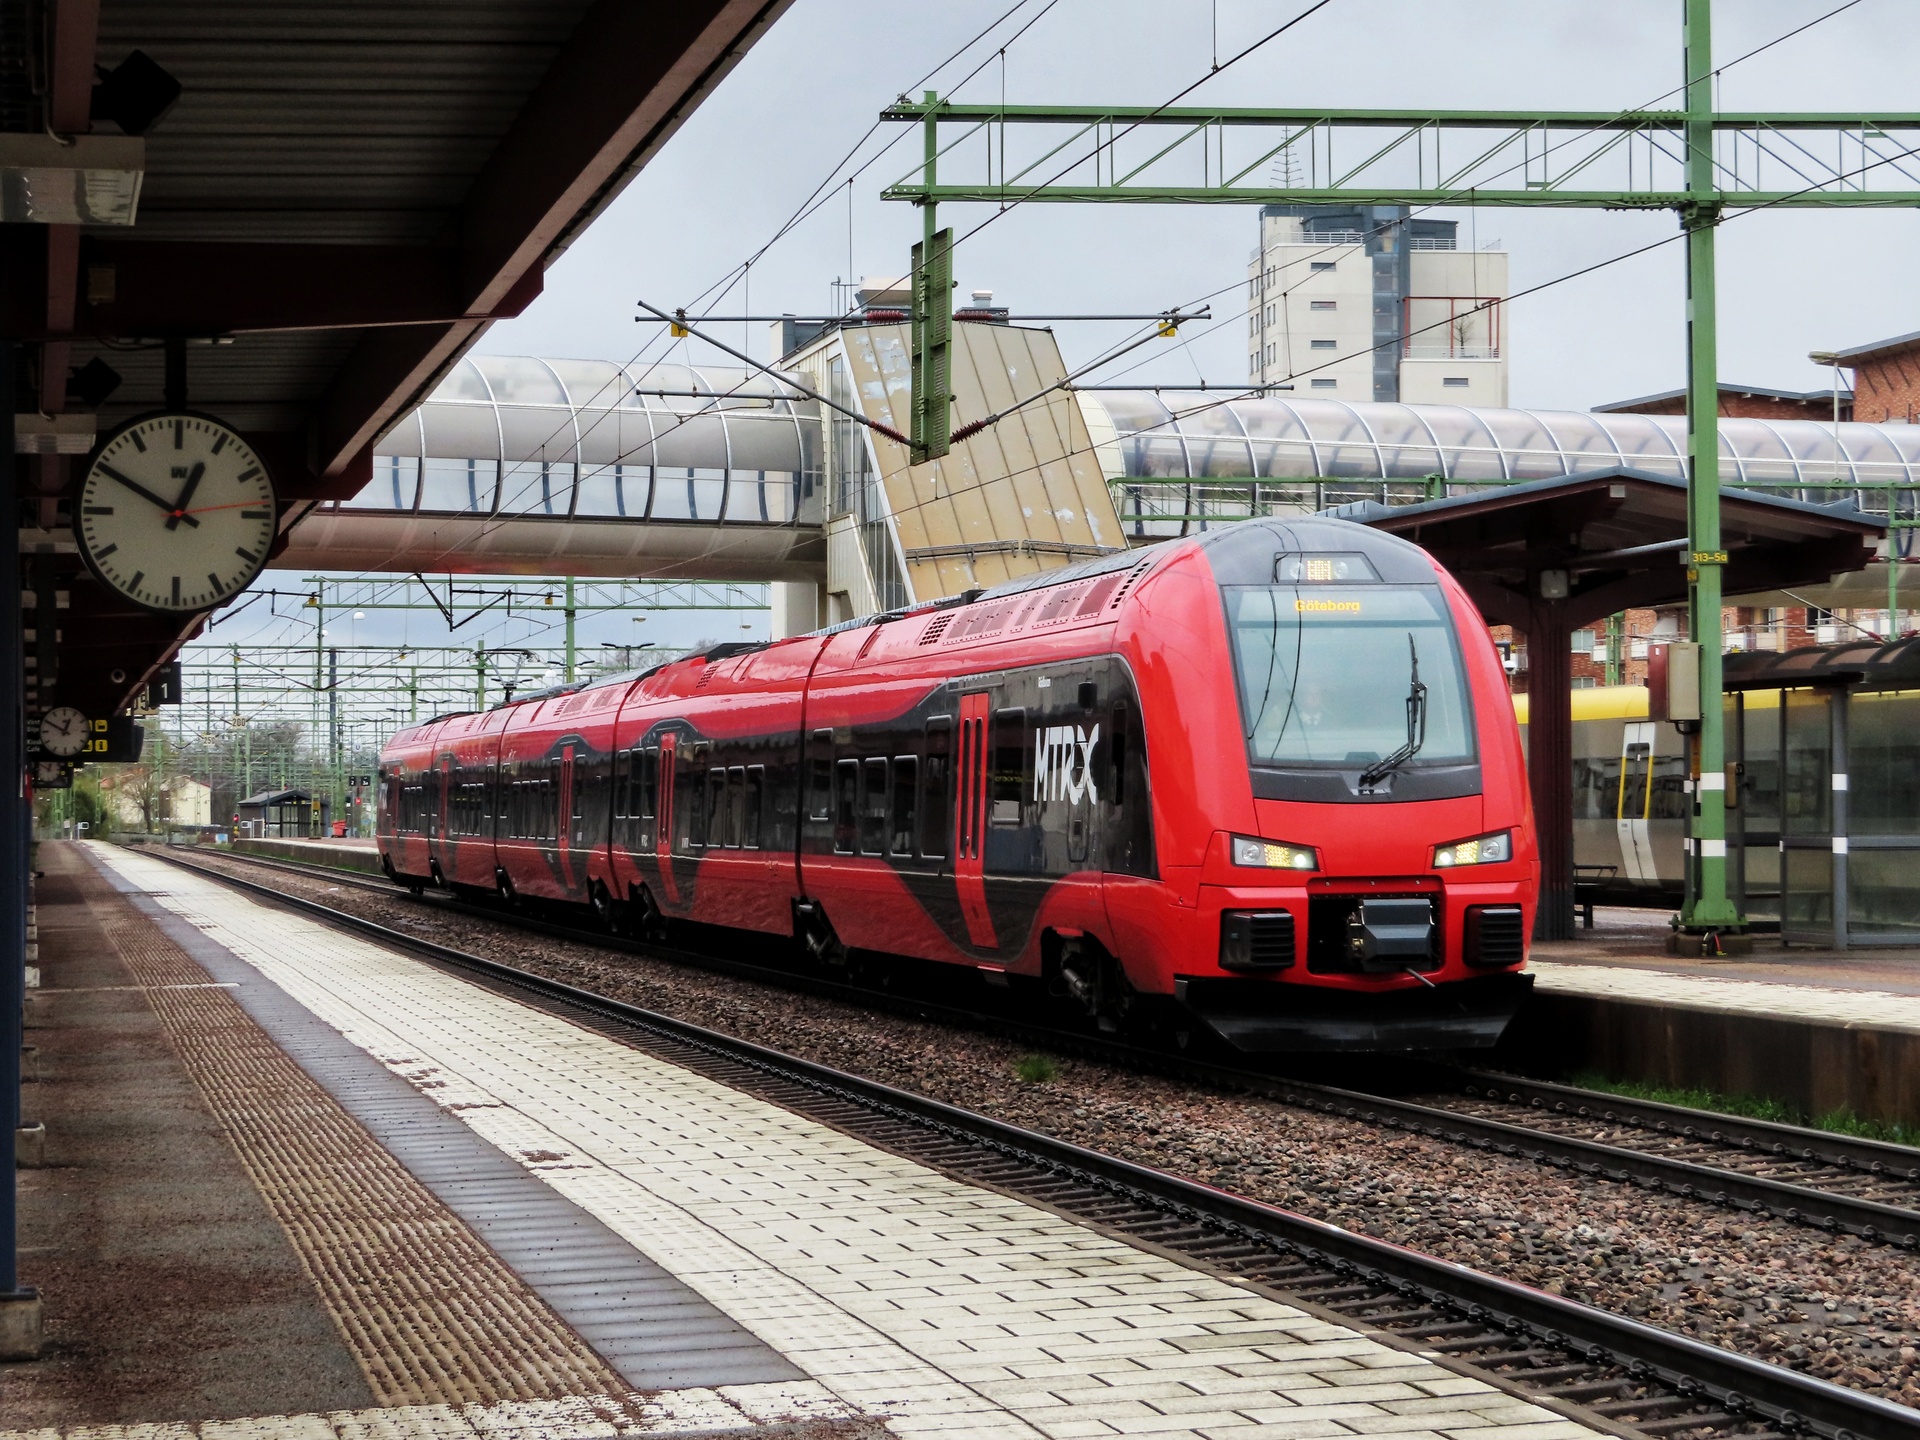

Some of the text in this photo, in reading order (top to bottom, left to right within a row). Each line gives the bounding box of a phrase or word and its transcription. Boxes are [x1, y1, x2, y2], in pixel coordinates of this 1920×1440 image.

[1295, 599, 1360, 614] Göteborg
[161, 682, 168, 699] 1
[232, 718, 246, 727] 200
